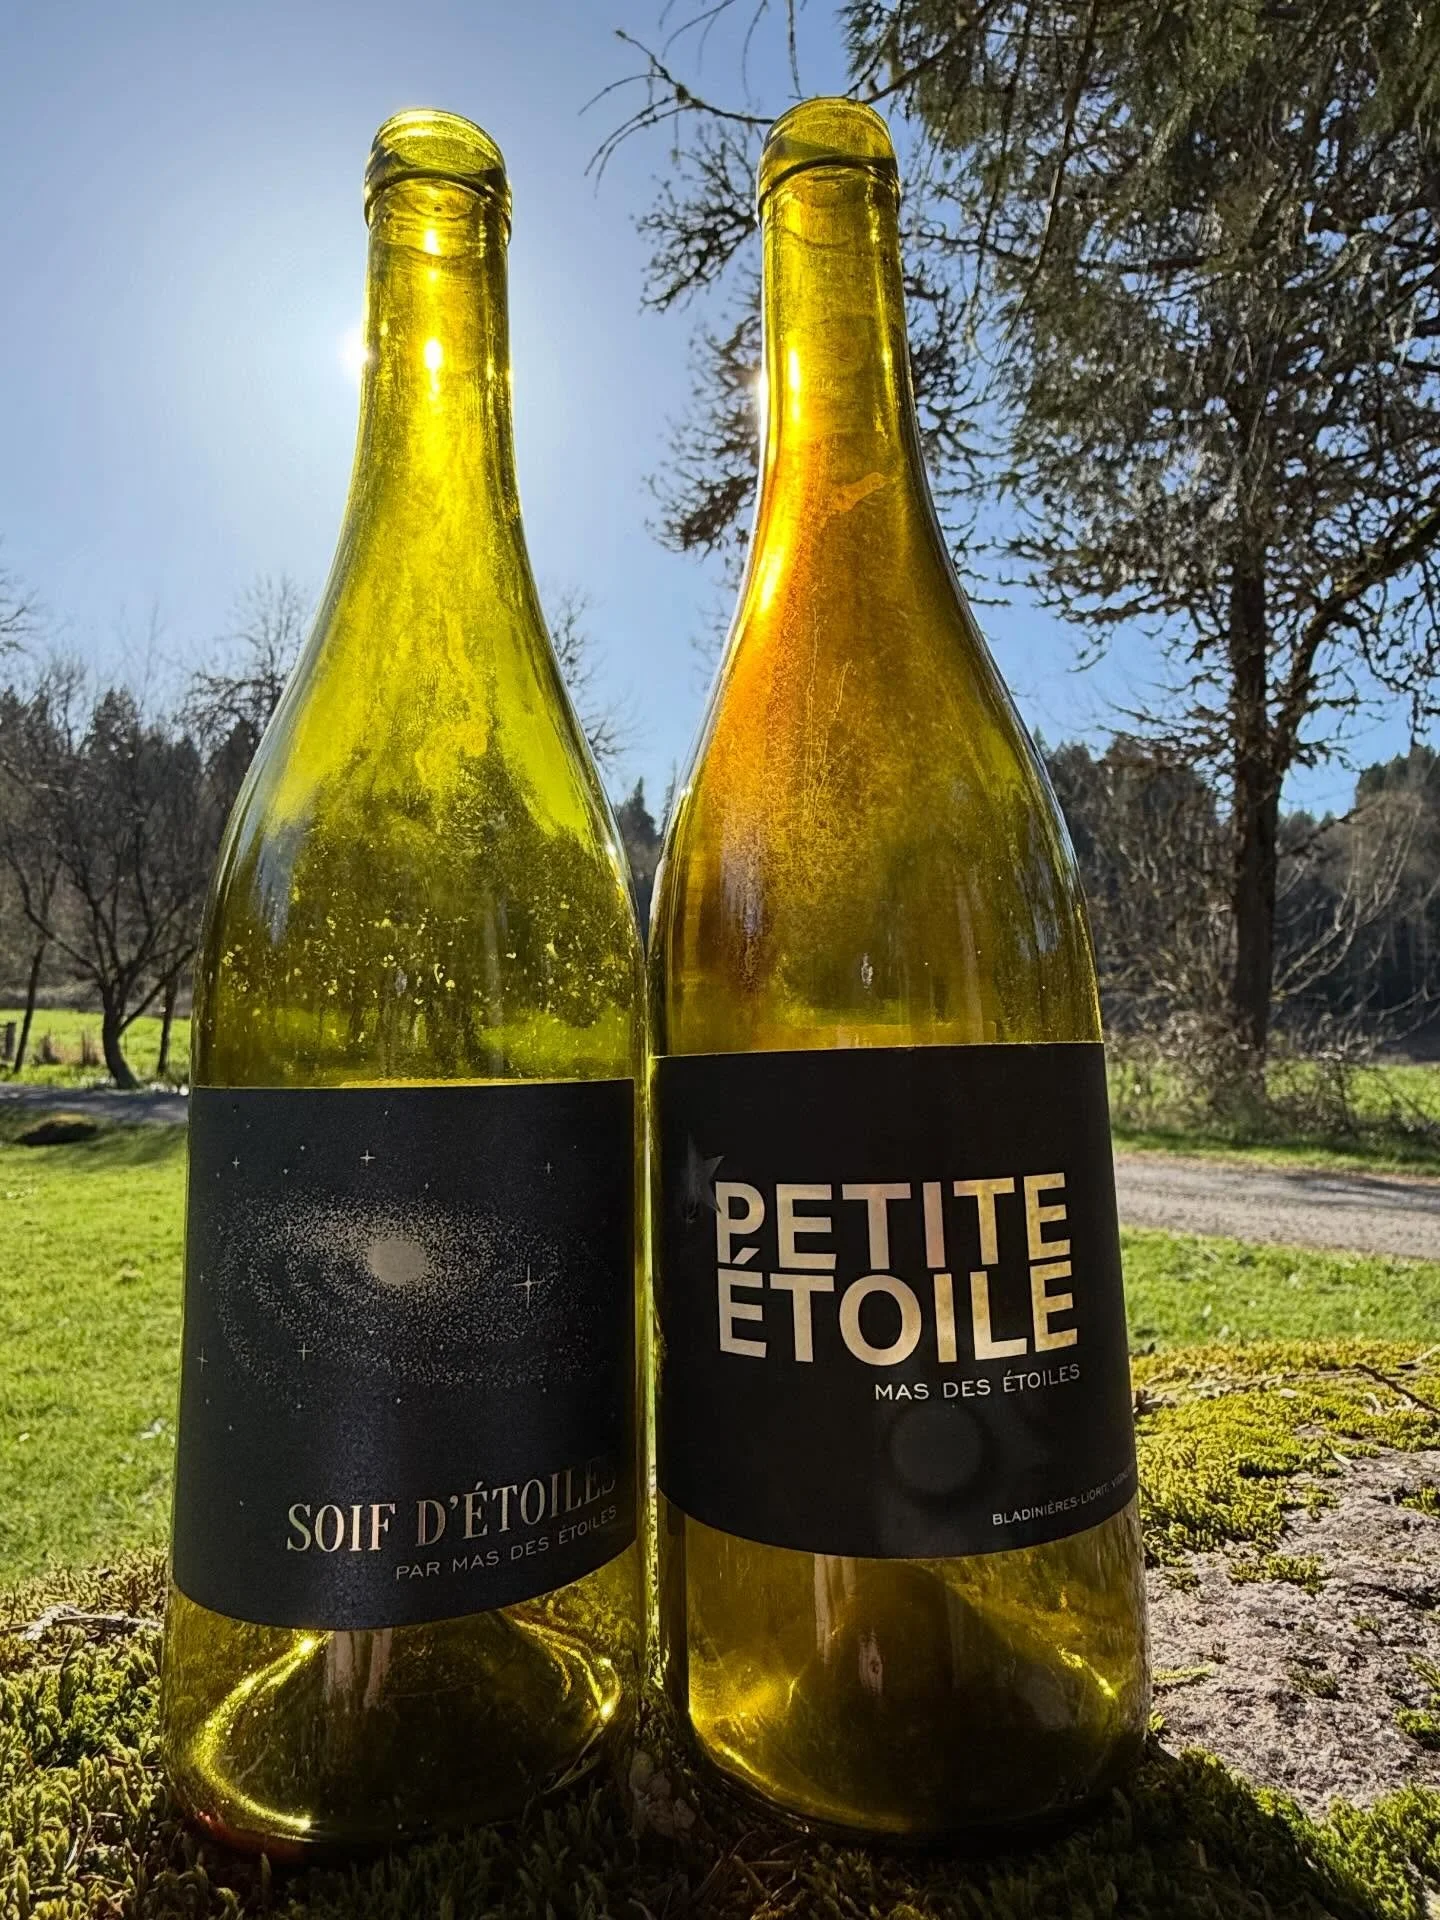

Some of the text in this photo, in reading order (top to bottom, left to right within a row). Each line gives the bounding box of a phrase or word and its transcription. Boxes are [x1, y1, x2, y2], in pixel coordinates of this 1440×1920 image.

[715, 1172, 1071, 1270] PETITE
[717, 1247, 1078, 1366] ÉTOILE
[875, 1363, 1081, 1401] MAS DES ÉTOILES
[287, 1502, 396, 1553] SOIF
[396, 1504, 617, 1580] PAR MAS DES ÉTOILES
